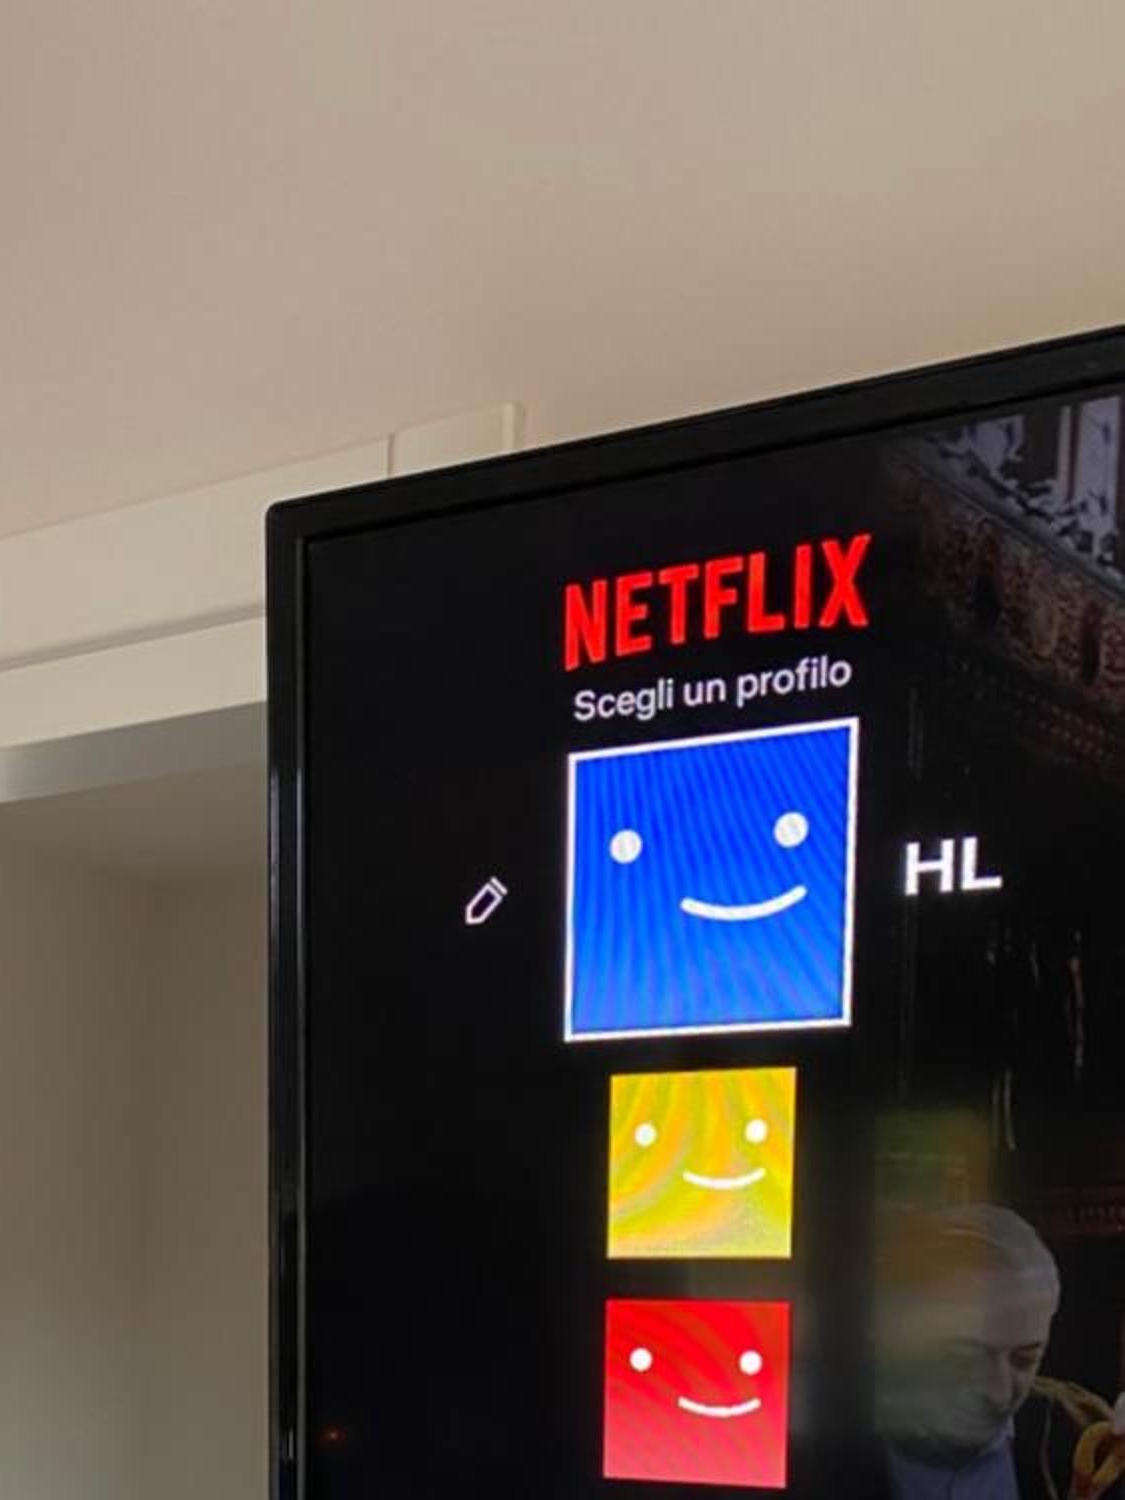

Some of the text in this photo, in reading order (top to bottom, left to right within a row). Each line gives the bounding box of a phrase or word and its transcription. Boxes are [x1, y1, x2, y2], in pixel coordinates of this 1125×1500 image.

[564, 533, 871, 672] NETFLIX
[573, 655, 853, 721] Scegli un profilo
[903, 836, 1003, 896] HL
